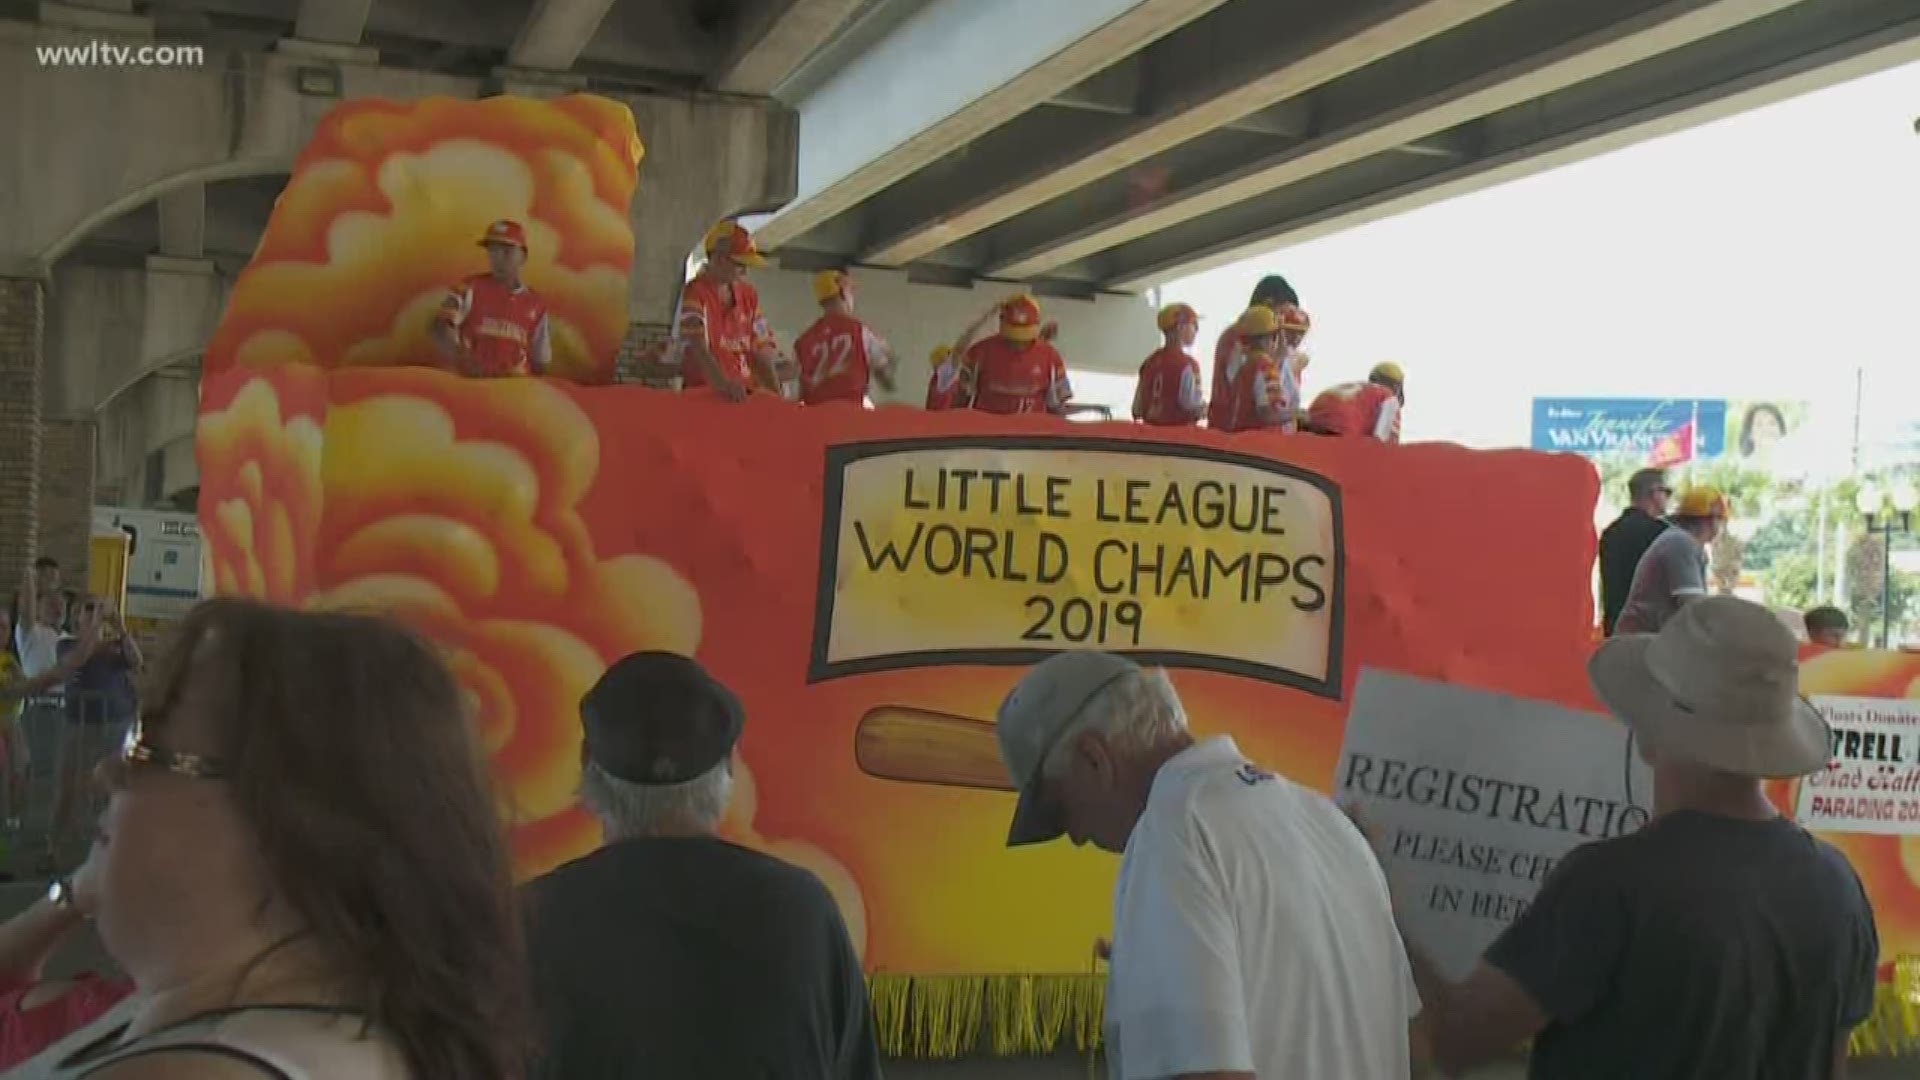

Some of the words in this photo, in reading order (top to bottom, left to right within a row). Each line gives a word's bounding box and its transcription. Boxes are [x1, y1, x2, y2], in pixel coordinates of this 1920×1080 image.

[812, 333, 852, 386] 22
[903, 468, 1072, 518] LITTLE
[1095, 479, 1288, 535] LEAGUE
[853, 520, 1069, 584] WORLD
[1093, 538, 1327, 612] CHAMPS
[1021, 595, 1143, 646] 2019
[1811, 796, 1894, 820] PARADING
[1393, 829, 1501, 874] PLEASE
[1428, 884, 1463, 912] IN
